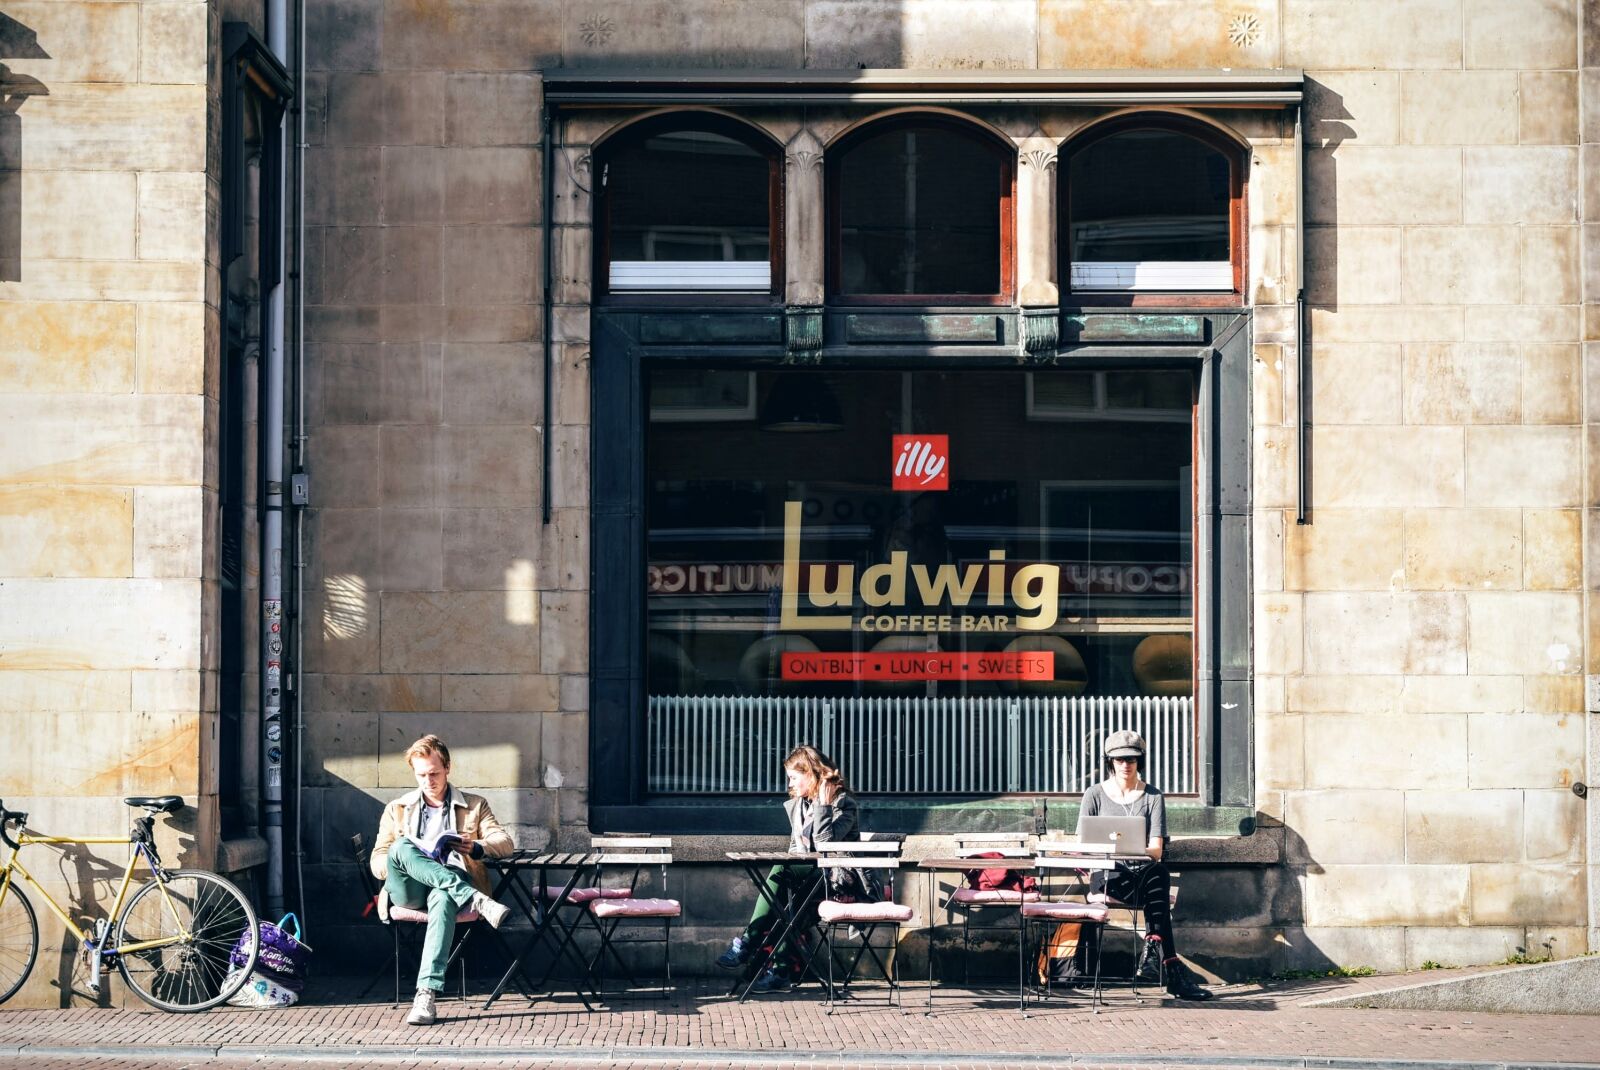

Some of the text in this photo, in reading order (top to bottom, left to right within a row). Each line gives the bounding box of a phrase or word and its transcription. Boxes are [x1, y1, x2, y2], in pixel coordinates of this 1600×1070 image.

[895, 441, 945, 485] illy
[781, 501, 1060, 630] Ludwig
[860, 615, 1009, 632] COFFEE BAR
[790, 659, 1045, 673] ONTBIJT LUNCH SWEETS
